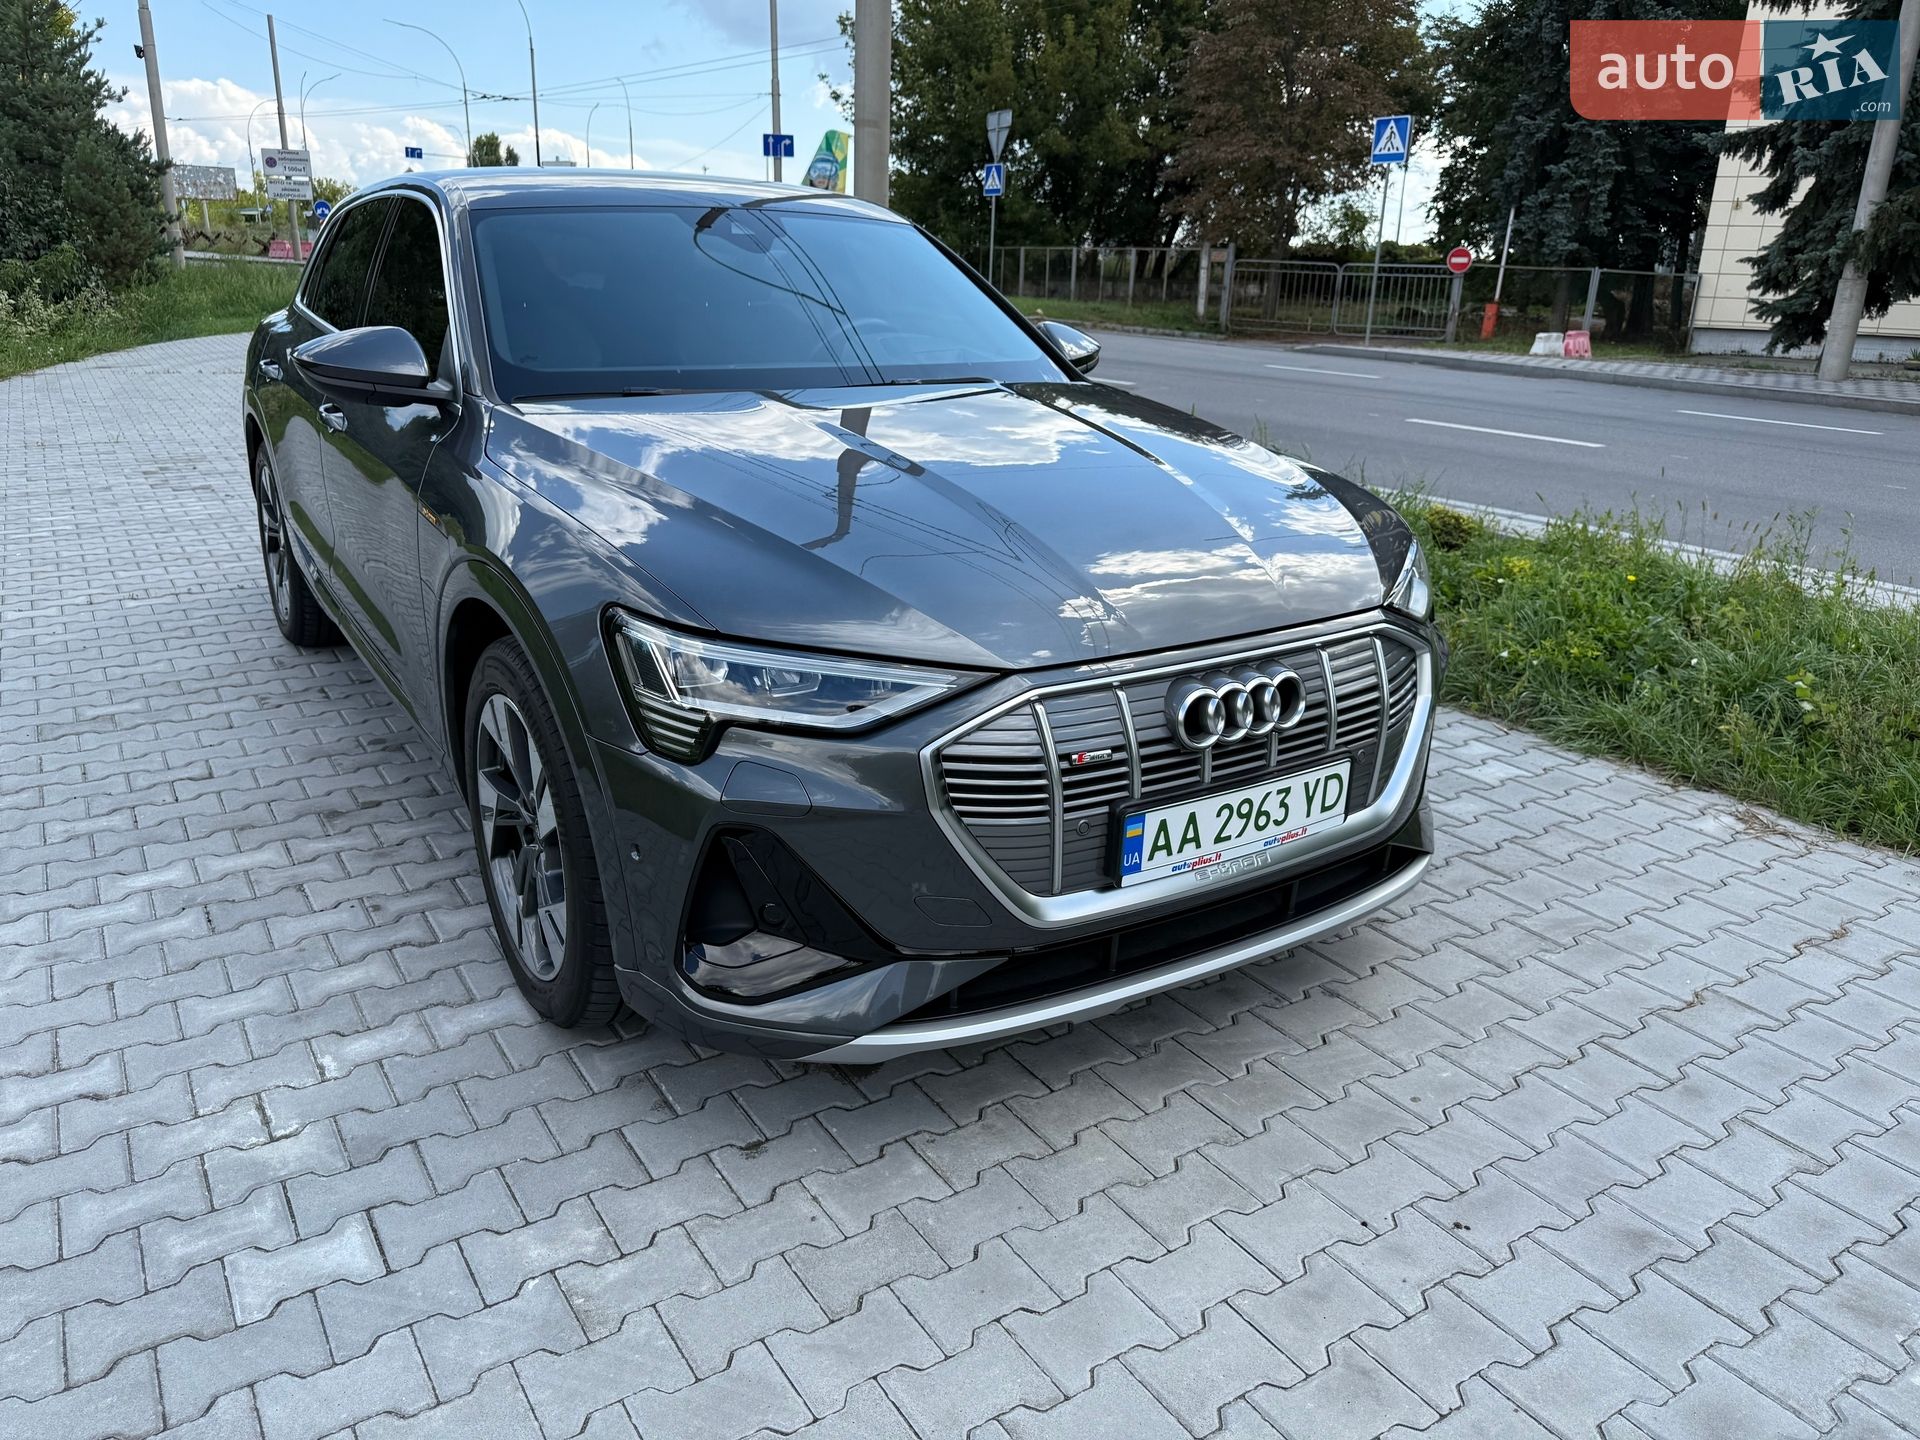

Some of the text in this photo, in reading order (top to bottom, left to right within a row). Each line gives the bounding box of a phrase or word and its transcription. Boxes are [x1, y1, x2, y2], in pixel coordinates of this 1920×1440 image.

[1147, 773, 1344, 862] AA 2963 YD
[1263, 827, 1308, 848] autoplius.lt
[1123, 854, 1140, 867] UA
[1171, 853, 1222, 873] autoplius.lt
[1194, 852, 1272, 882] e-tron
